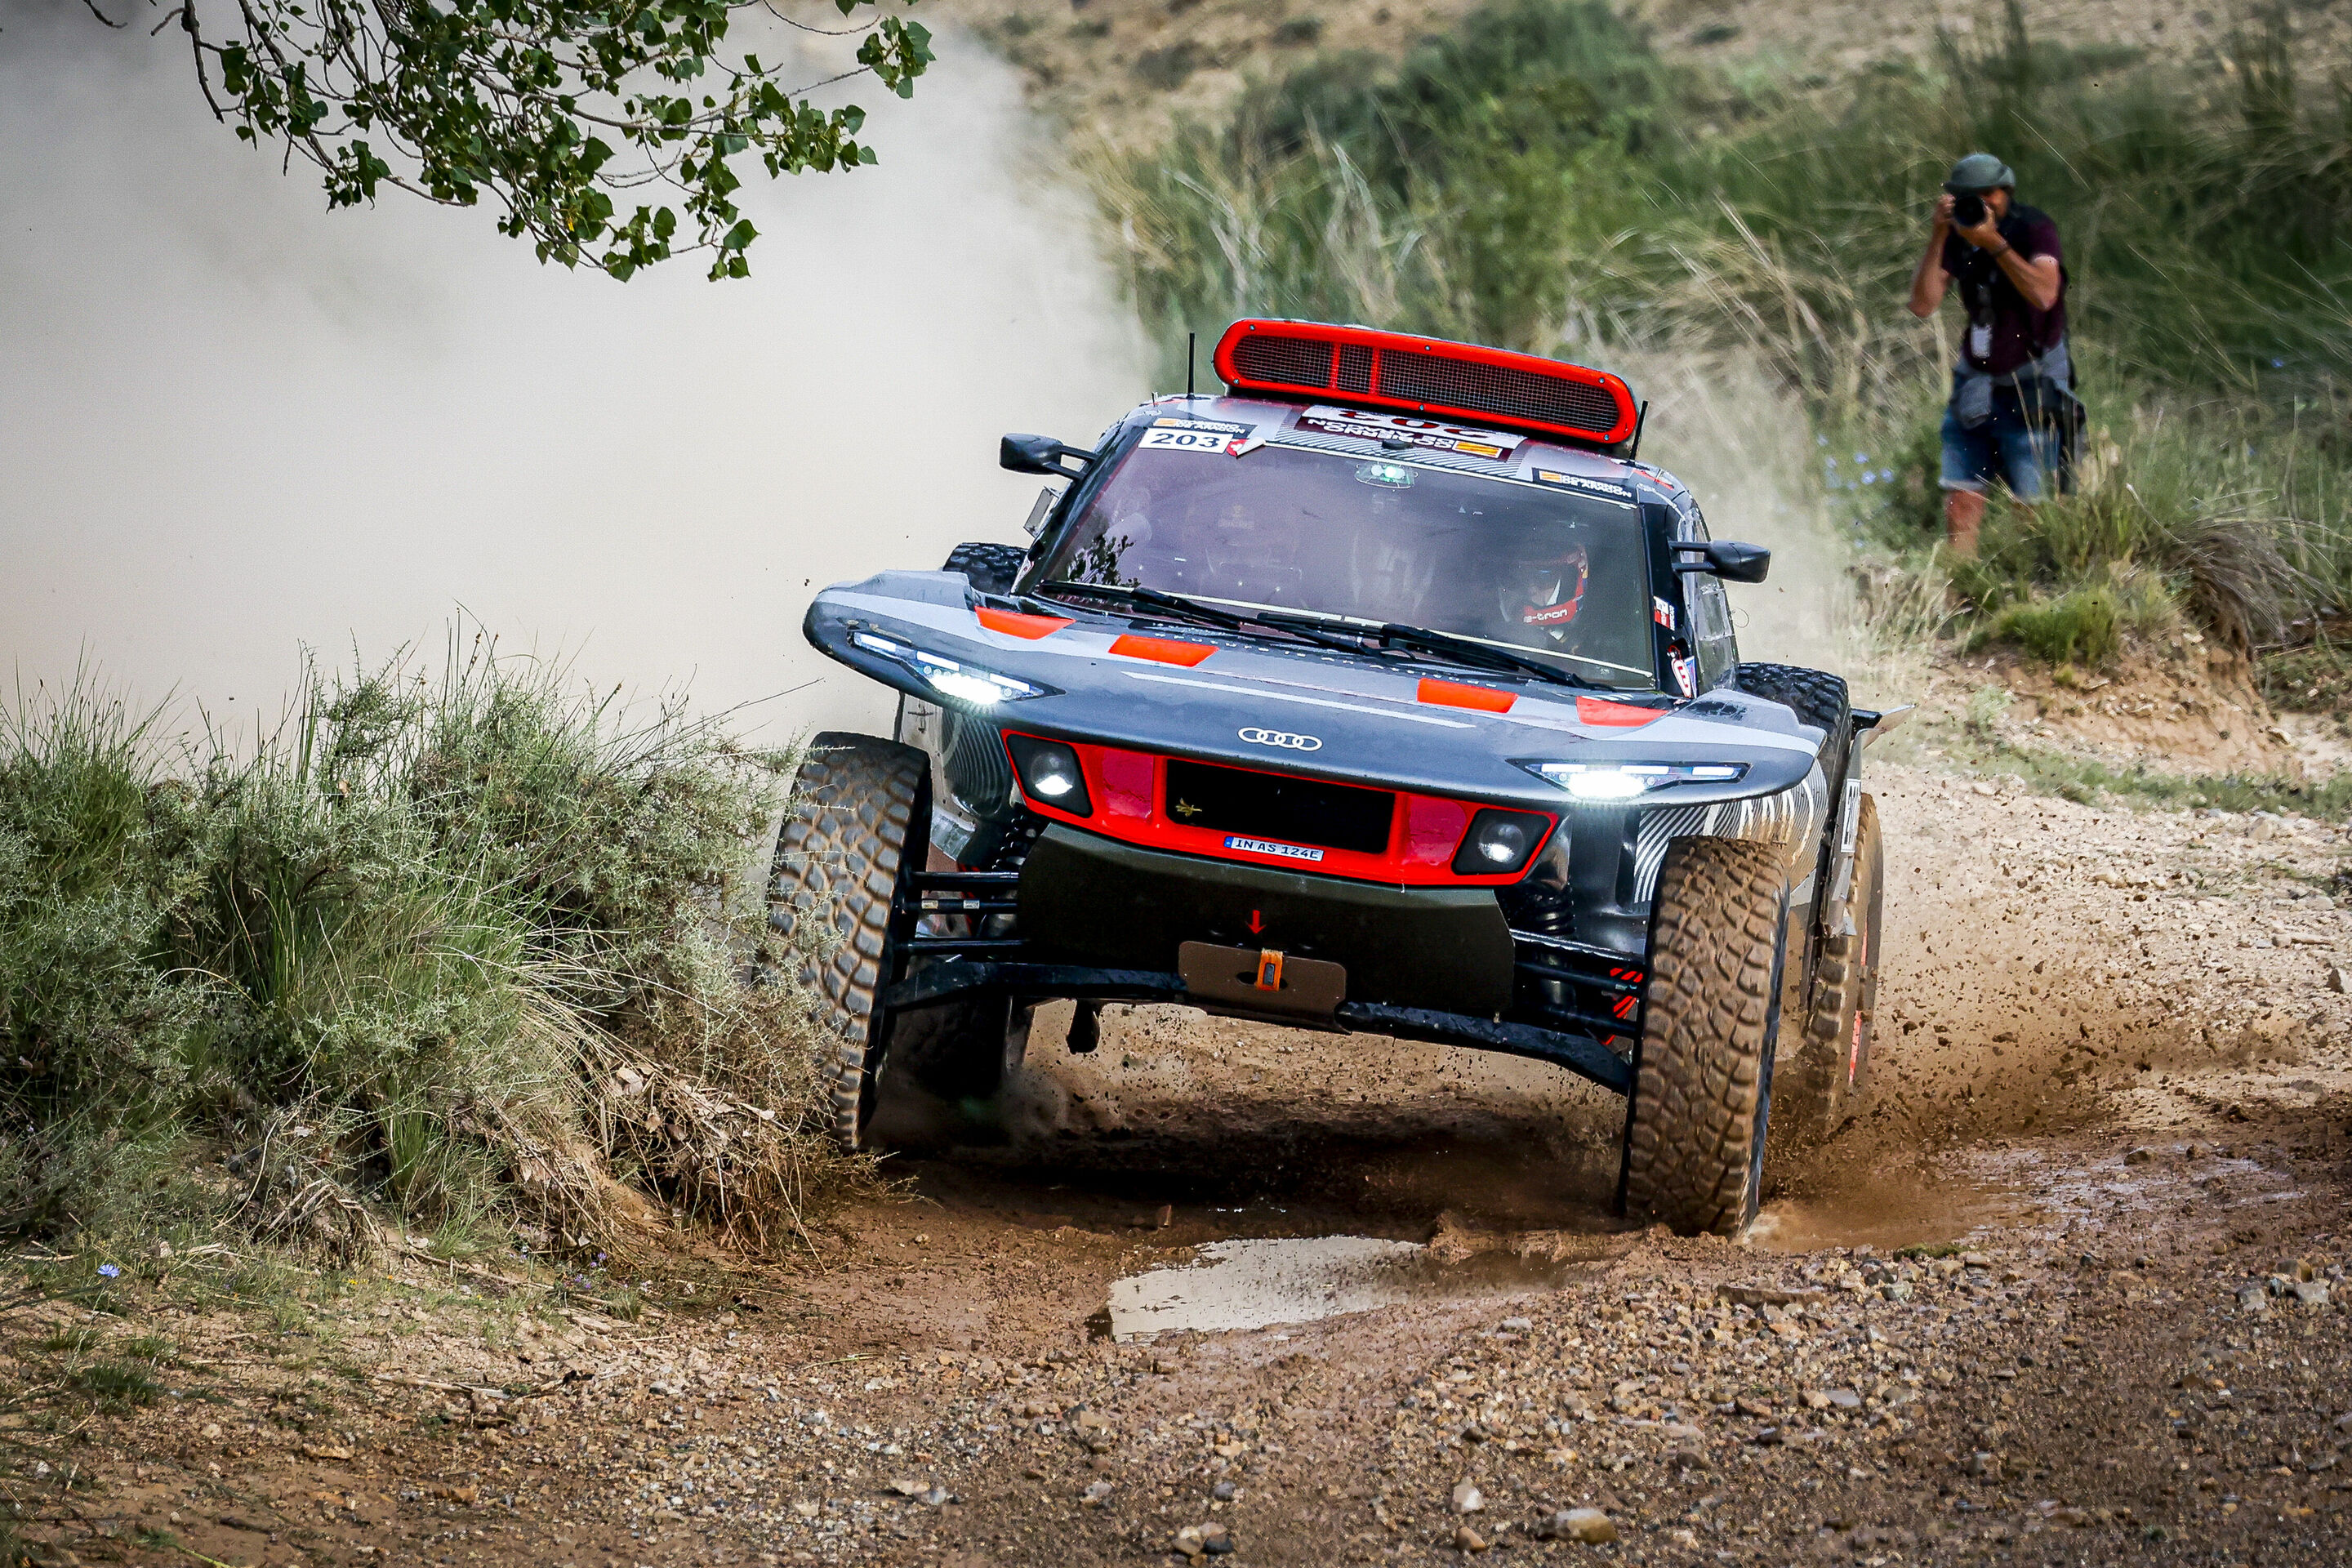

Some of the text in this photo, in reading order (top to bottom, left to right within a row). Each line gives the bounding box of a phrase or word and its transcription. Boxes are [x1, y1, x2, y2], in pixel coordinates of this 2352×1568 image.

[1151, 432, 1220, 448] 203
[1523, 608, 1568, 623] e-tron
[1236, 840, 1319, 859] IN AS 124E
